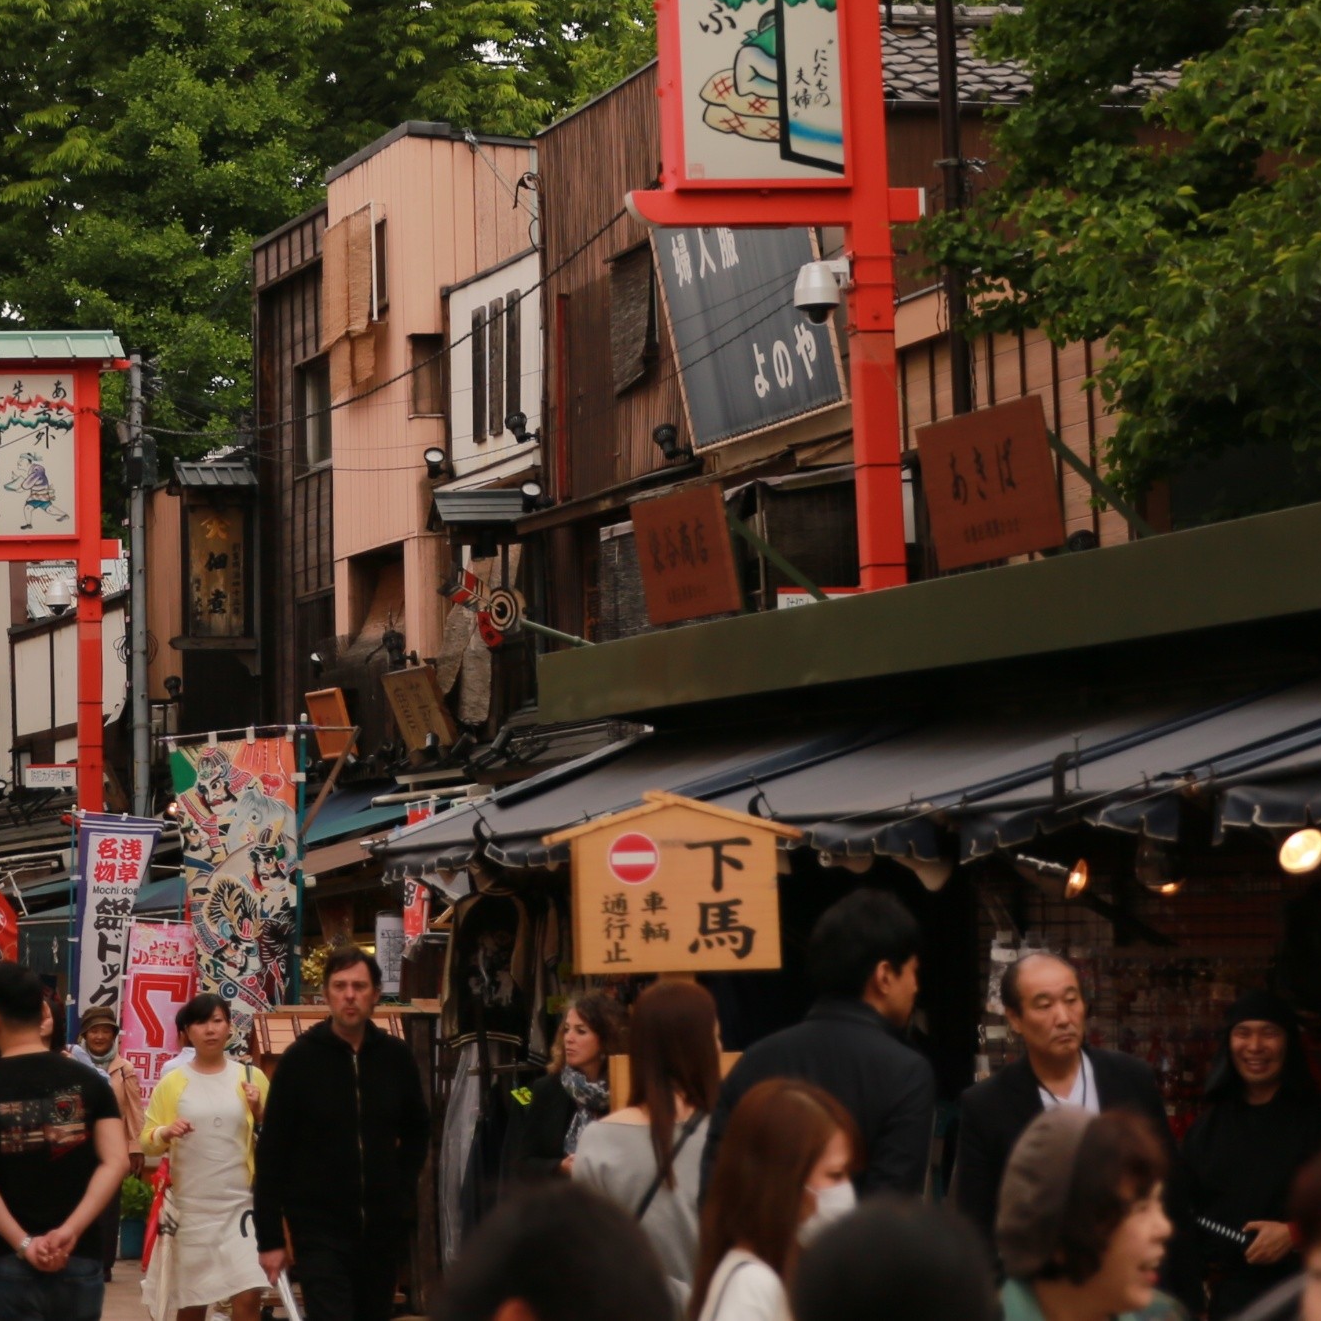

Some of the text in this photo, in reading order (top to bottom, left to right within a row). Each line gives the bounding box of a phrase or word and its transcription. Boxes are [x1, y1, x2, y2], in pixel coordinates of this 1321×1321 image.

[752, 321, 818, 399] よのや
[92, 884, 119, 895] Mochi
[93, 837, 119, 884] 名物
[116, 838, 143, 884] 浅草
[684, 836, 757, 960] 下馬
[601, 892, 633, 965] 通行止
